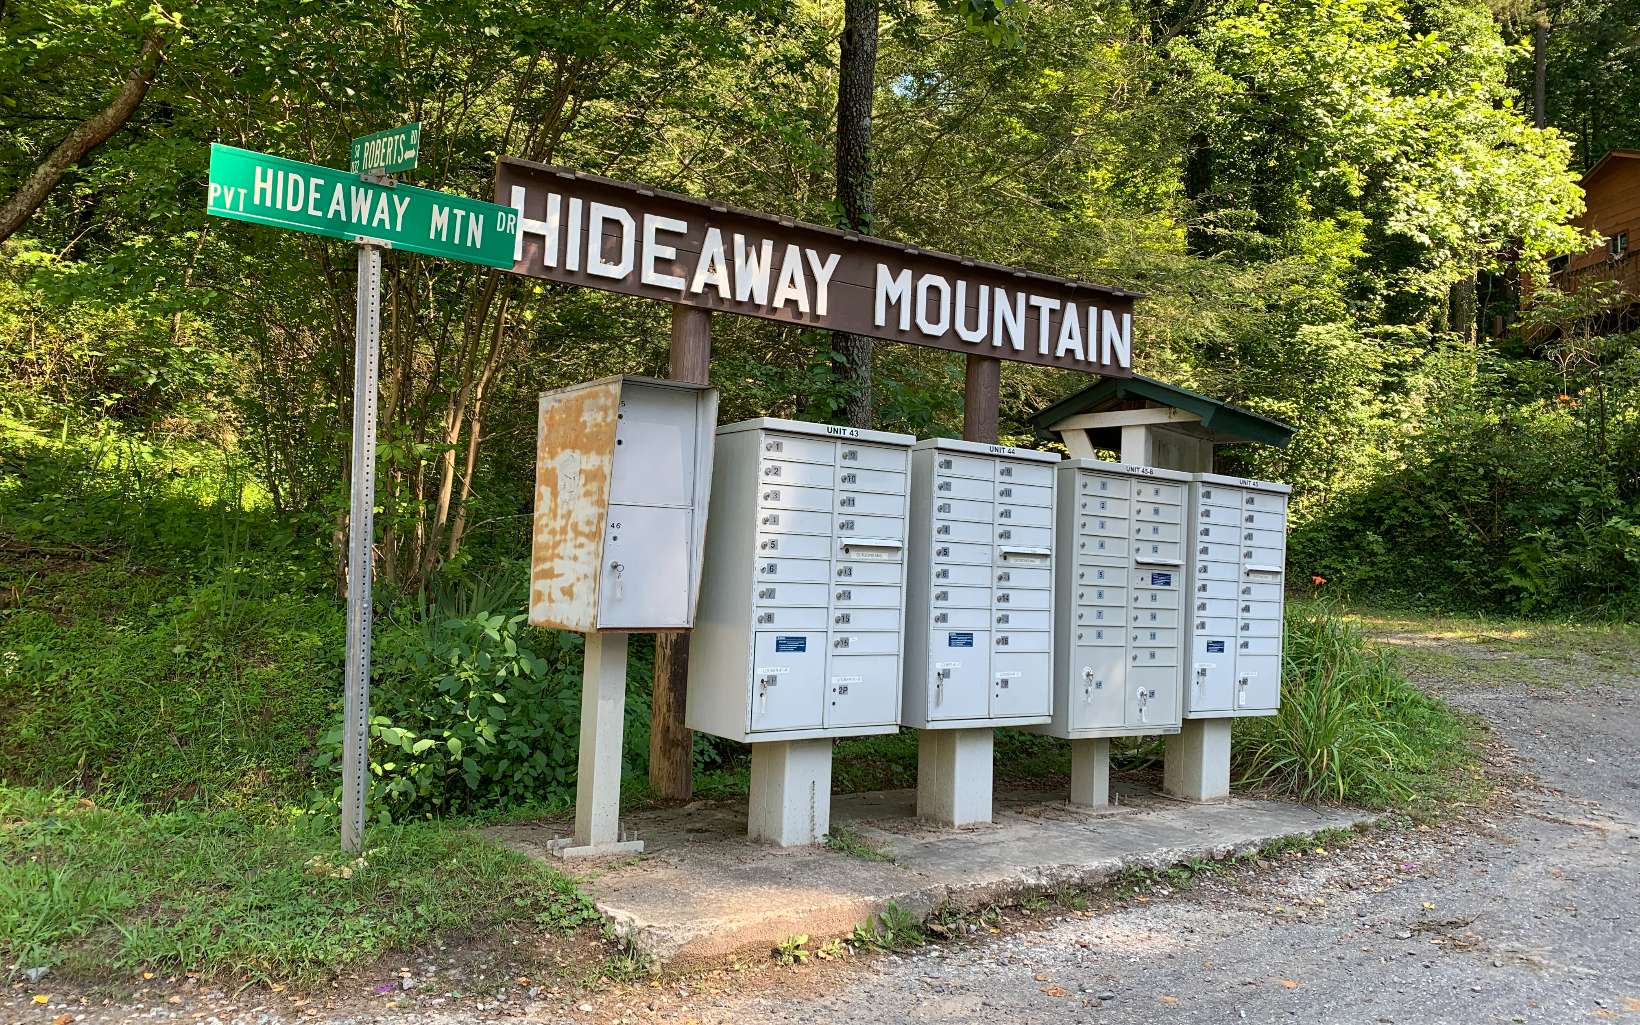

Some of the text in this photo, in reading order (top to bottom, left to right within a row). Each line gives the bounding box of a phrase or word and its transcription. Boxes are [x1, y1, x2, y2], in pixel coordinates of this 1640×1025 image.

[363, 134, 405, 170] ROBERTS
[208, 166, 516, 248] PVT HIDEAWAY MTN DR
[511, 185, 1132, 368] HIDEAWAY MOUNTAIN
[827, 426, 859, 437] UNIT 43
[990, 445, 1005, 453] UNIT
